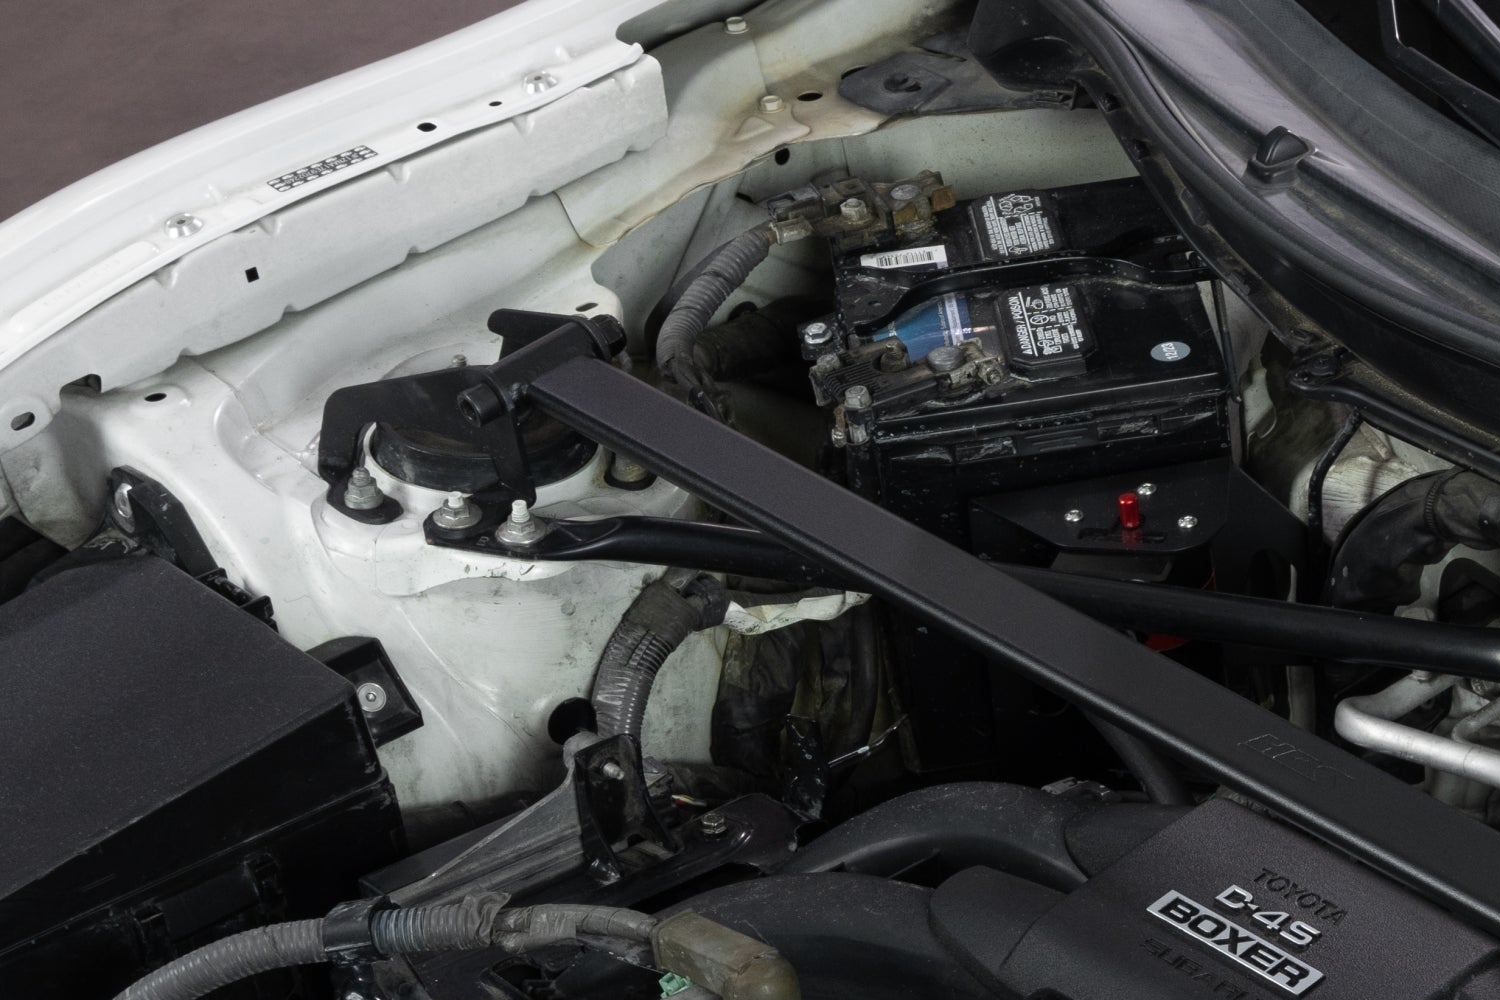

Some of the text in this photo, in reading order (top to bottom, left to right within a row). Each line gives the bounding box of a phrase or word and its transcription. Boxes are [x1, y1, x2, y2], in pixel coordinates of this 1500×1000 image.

[1008, 296, 1022, 319] POISON
[1015, 323, 1031, 349] DANGER
[1160, 342, 1178, 359] 12/23
[1215, 884, 1322, 949] D-4S
[1253, 867, 1350, 927] TOYOTA
[1157, 895, 1312, 989] BOXER
